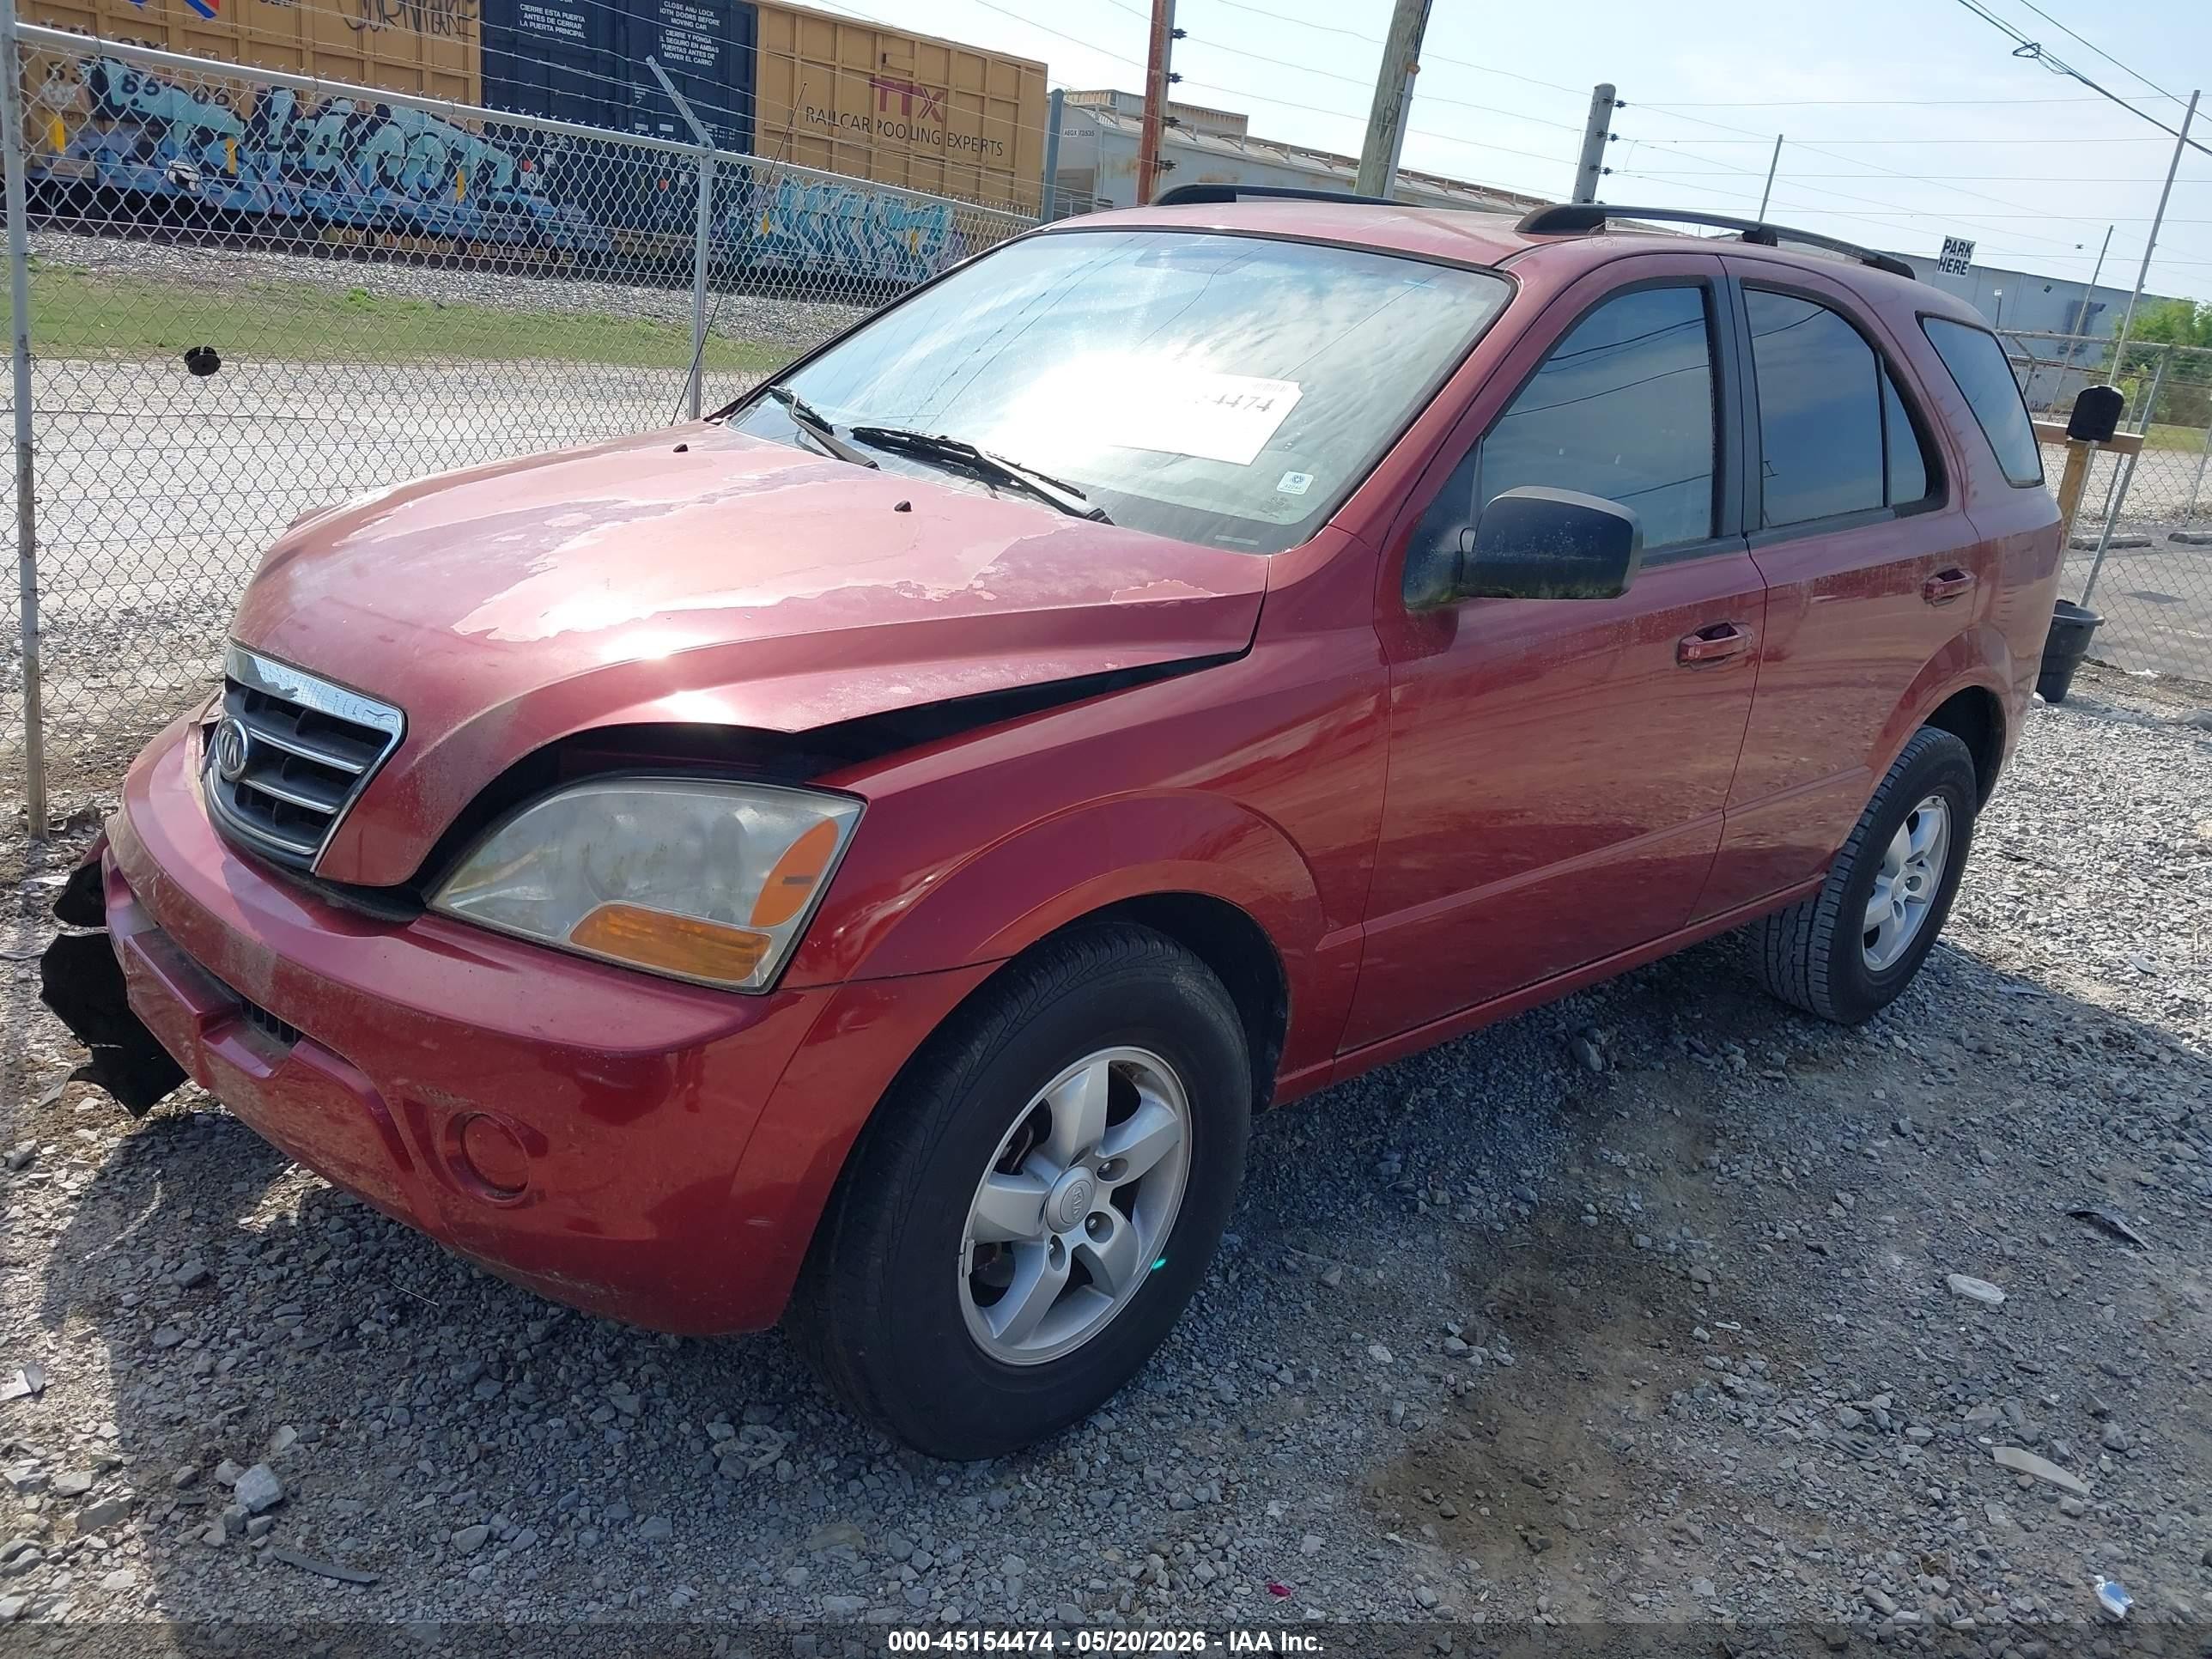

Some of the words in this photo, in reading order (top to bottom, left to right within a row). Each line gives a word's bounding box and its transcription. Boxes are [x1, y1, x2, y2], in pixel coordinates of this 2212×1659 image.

[520, 3, 543, 14] CIERRE
[544, 9, 561, 17] ESTA
[562, 12, 585, 22] PUERTA
[664, 1, 684, 10] CLOSE
[698, 9, 714, 17] LOCK
[524, 12, 545, 22] ANTES
[556, 20, 582, 30] CERRAR
[671, 17, 694, 27] MOVING
[695, 22, 707, 31] CAR
[676, 11, 696, 21] DOORS
[697, 16, 720, 26] BEFORE
[529, 21, 554, 32] PUERTA
[555, 27, 586, 39] PRINCIPAL
[665, 29, 686, 39] CIERRE
[692, 35, 712, 45] PONGA
[661, 43, 687, 54] PUERTAS
[688, 49, 706, 58] ANTES
[665, 37, 690, 47] SEGURO
[699, 44, 720, 53] AMBAS
[664, 52, 684, 61] MOVER
[693, 58, 713, 66] CARRO
[869, 78, 946, 124] TTX
[805, 106, 871, 132] RAILCAR
[877, 119, 941, 145] POOLING
[947, 131, 1003, 156] EXPERTS
[1942, 238, 1975, 258] PARK
[1936, 257, 1969, 276] HERE
